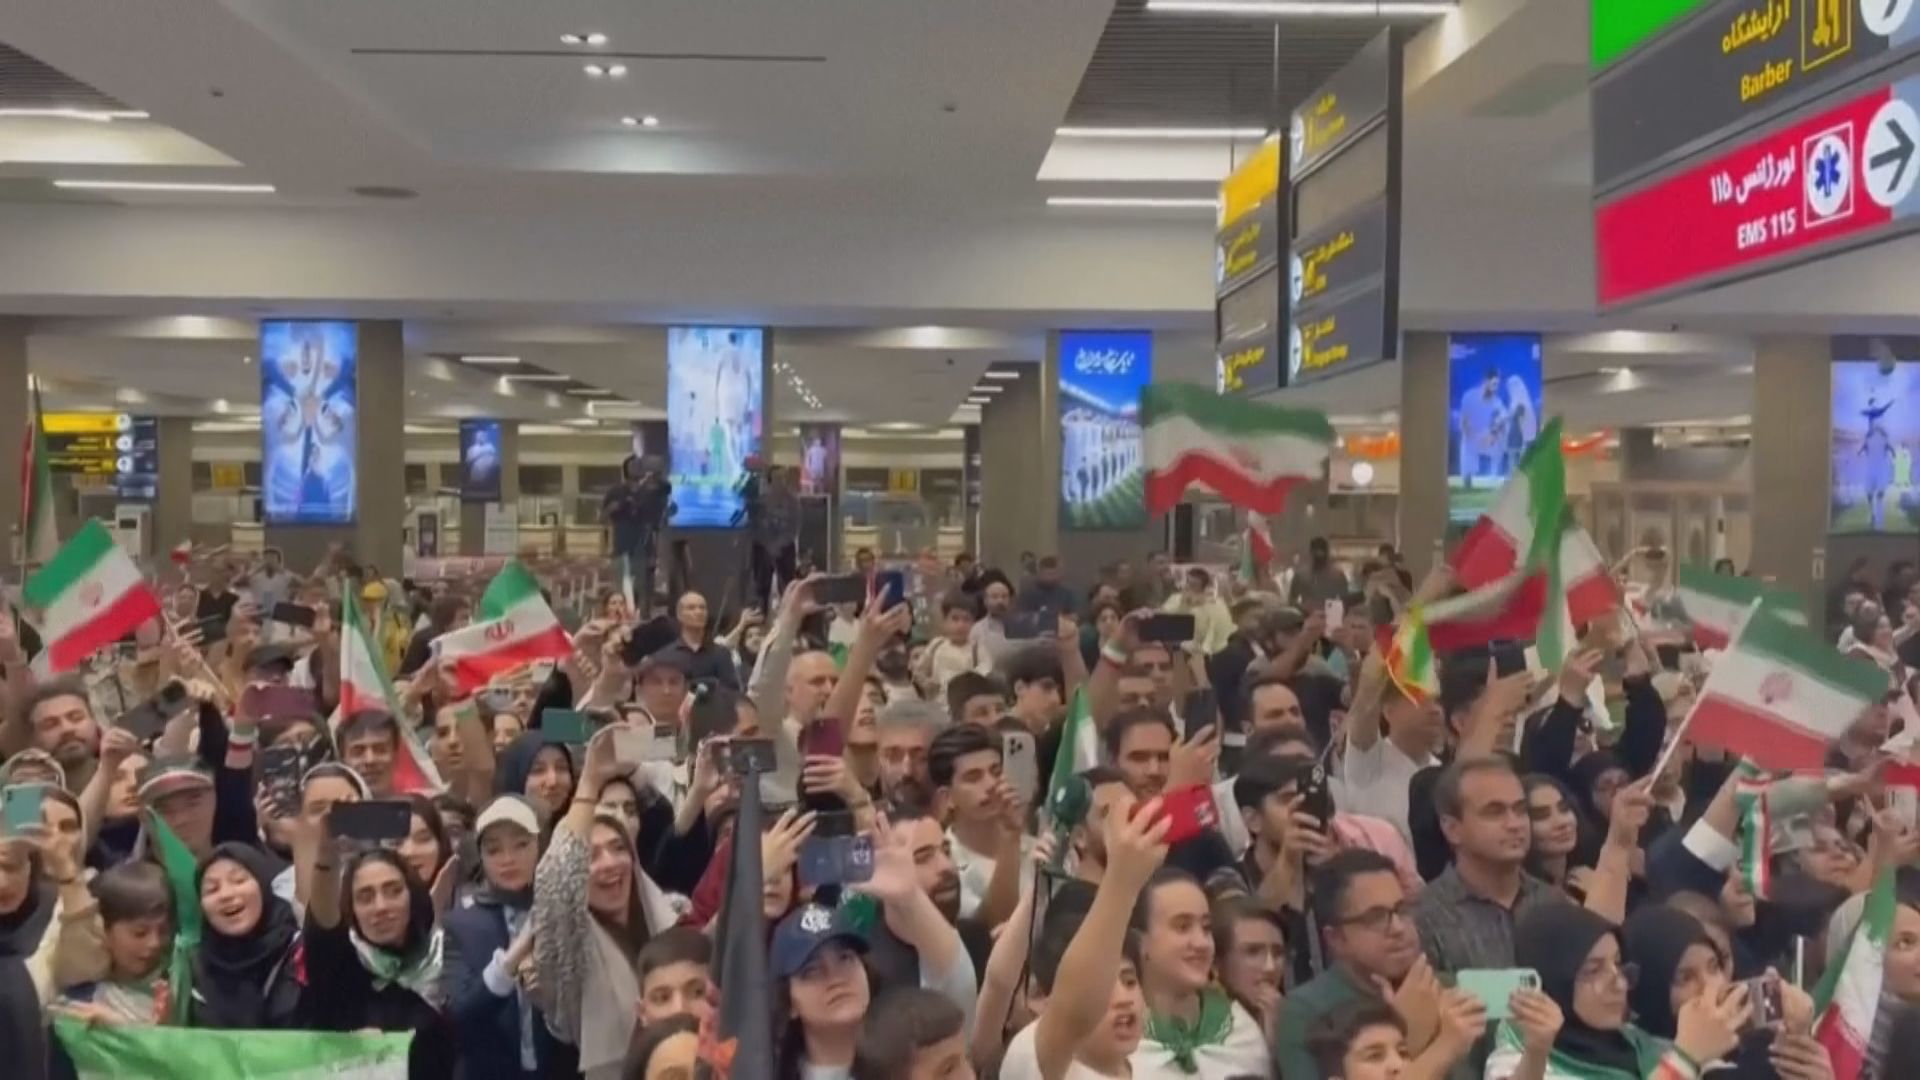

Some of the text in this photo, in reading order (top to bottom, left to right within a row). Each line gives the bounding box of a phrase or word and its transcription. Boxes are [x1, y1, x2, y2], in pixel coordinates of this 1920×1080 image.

[1740, 58, 1793, 102] Barber
[1736, 145, 1796, 205] اورژانس
[1737, 206, 1797, 250] EMS 115
